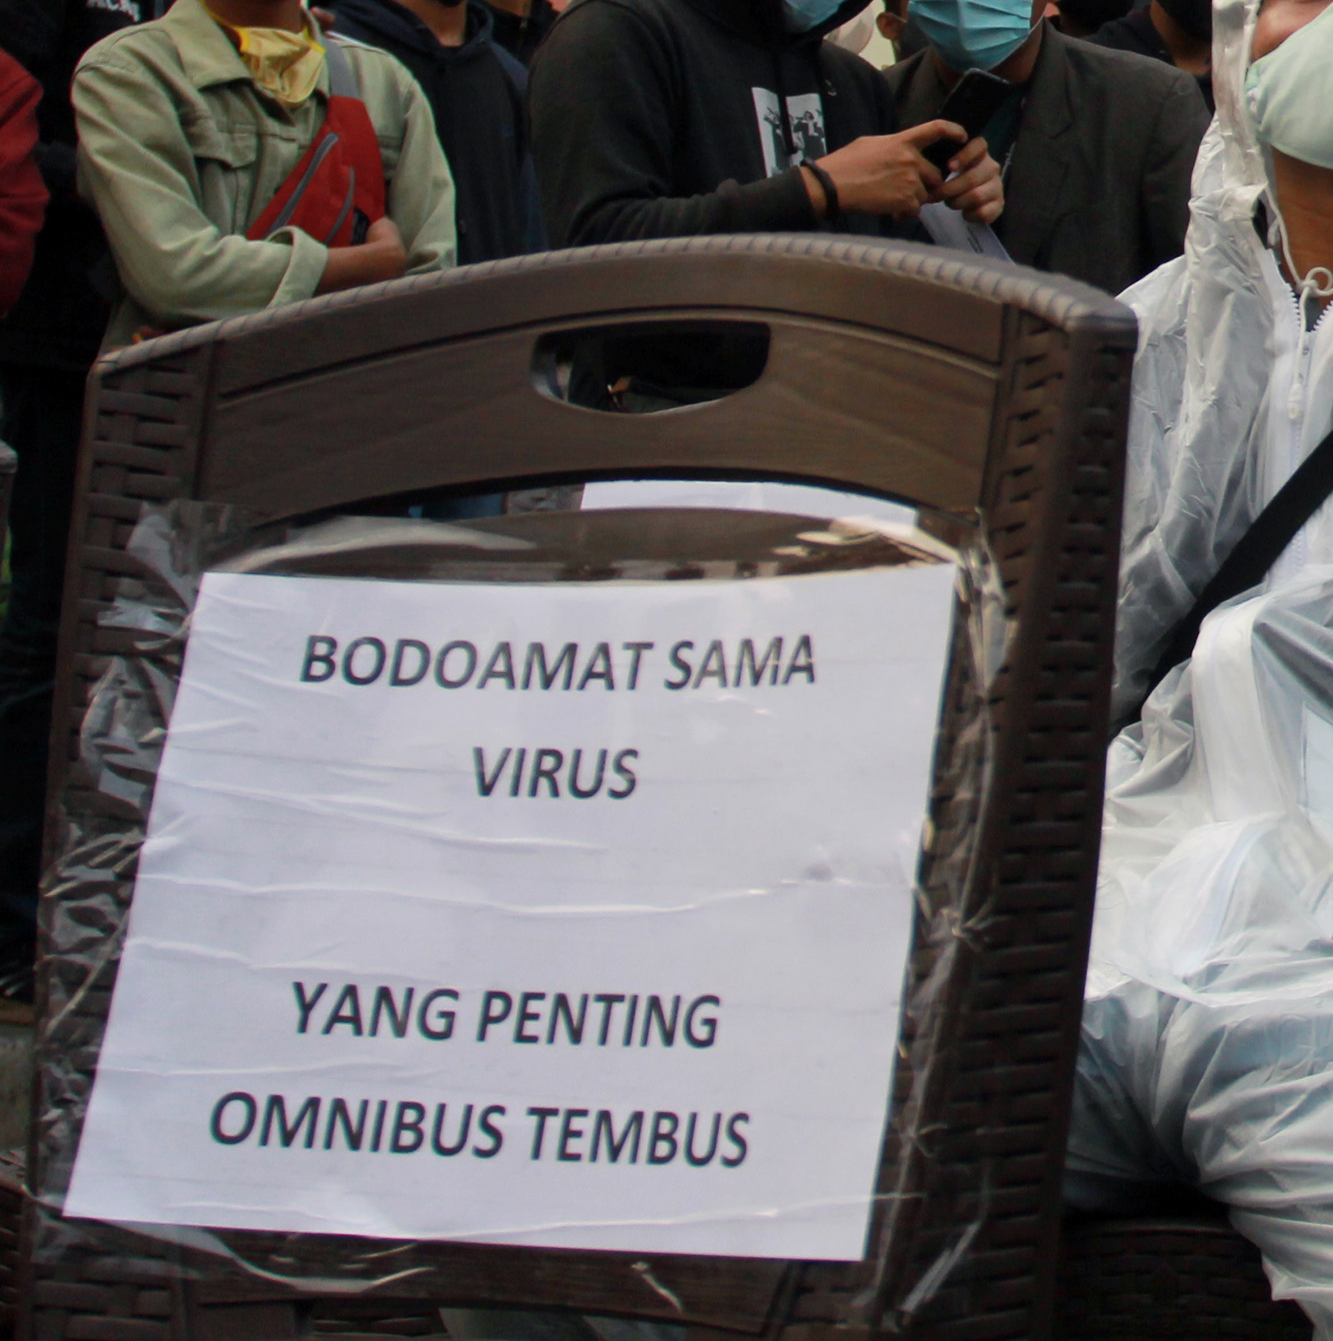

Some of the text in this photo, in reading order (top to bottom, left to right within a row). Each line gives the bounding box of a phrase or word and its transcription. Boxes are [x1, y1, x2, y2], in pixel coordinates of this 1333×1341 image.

[301, 635, 817, 691] BODOAMAT SAMA
[472, 746, 640, 800] VIRUS
[292, 981, 722, 1049] YANG PENTING
[209, 1091, 752, 1168] OMNIBUS TEMBUS
